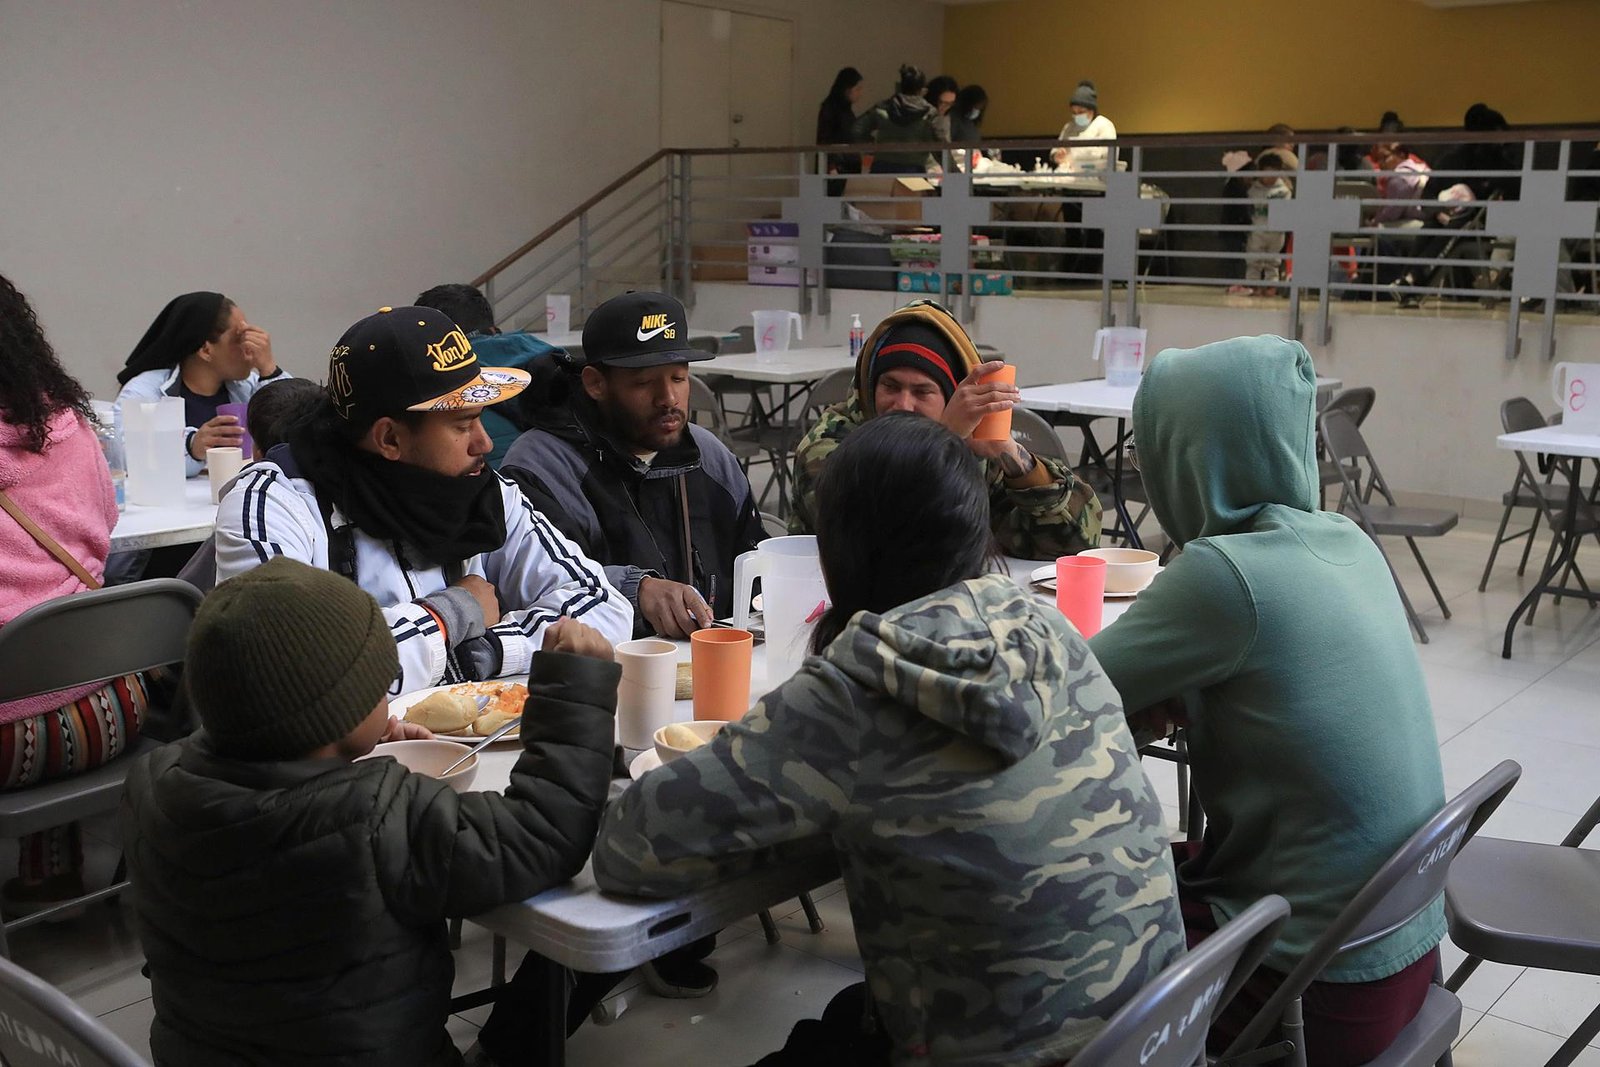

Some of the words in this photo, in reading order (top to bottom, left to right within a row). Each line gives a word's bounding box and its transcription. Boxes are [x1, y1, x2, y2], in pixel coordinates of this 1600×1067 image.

[641, 313, 668, 330] NIKE
[663, 328, 676, 339] SB
[762, 322, 778, 351] 6
[1127, 340, 1142, 366] 7
[1568, 378, 1586, 412] 8
